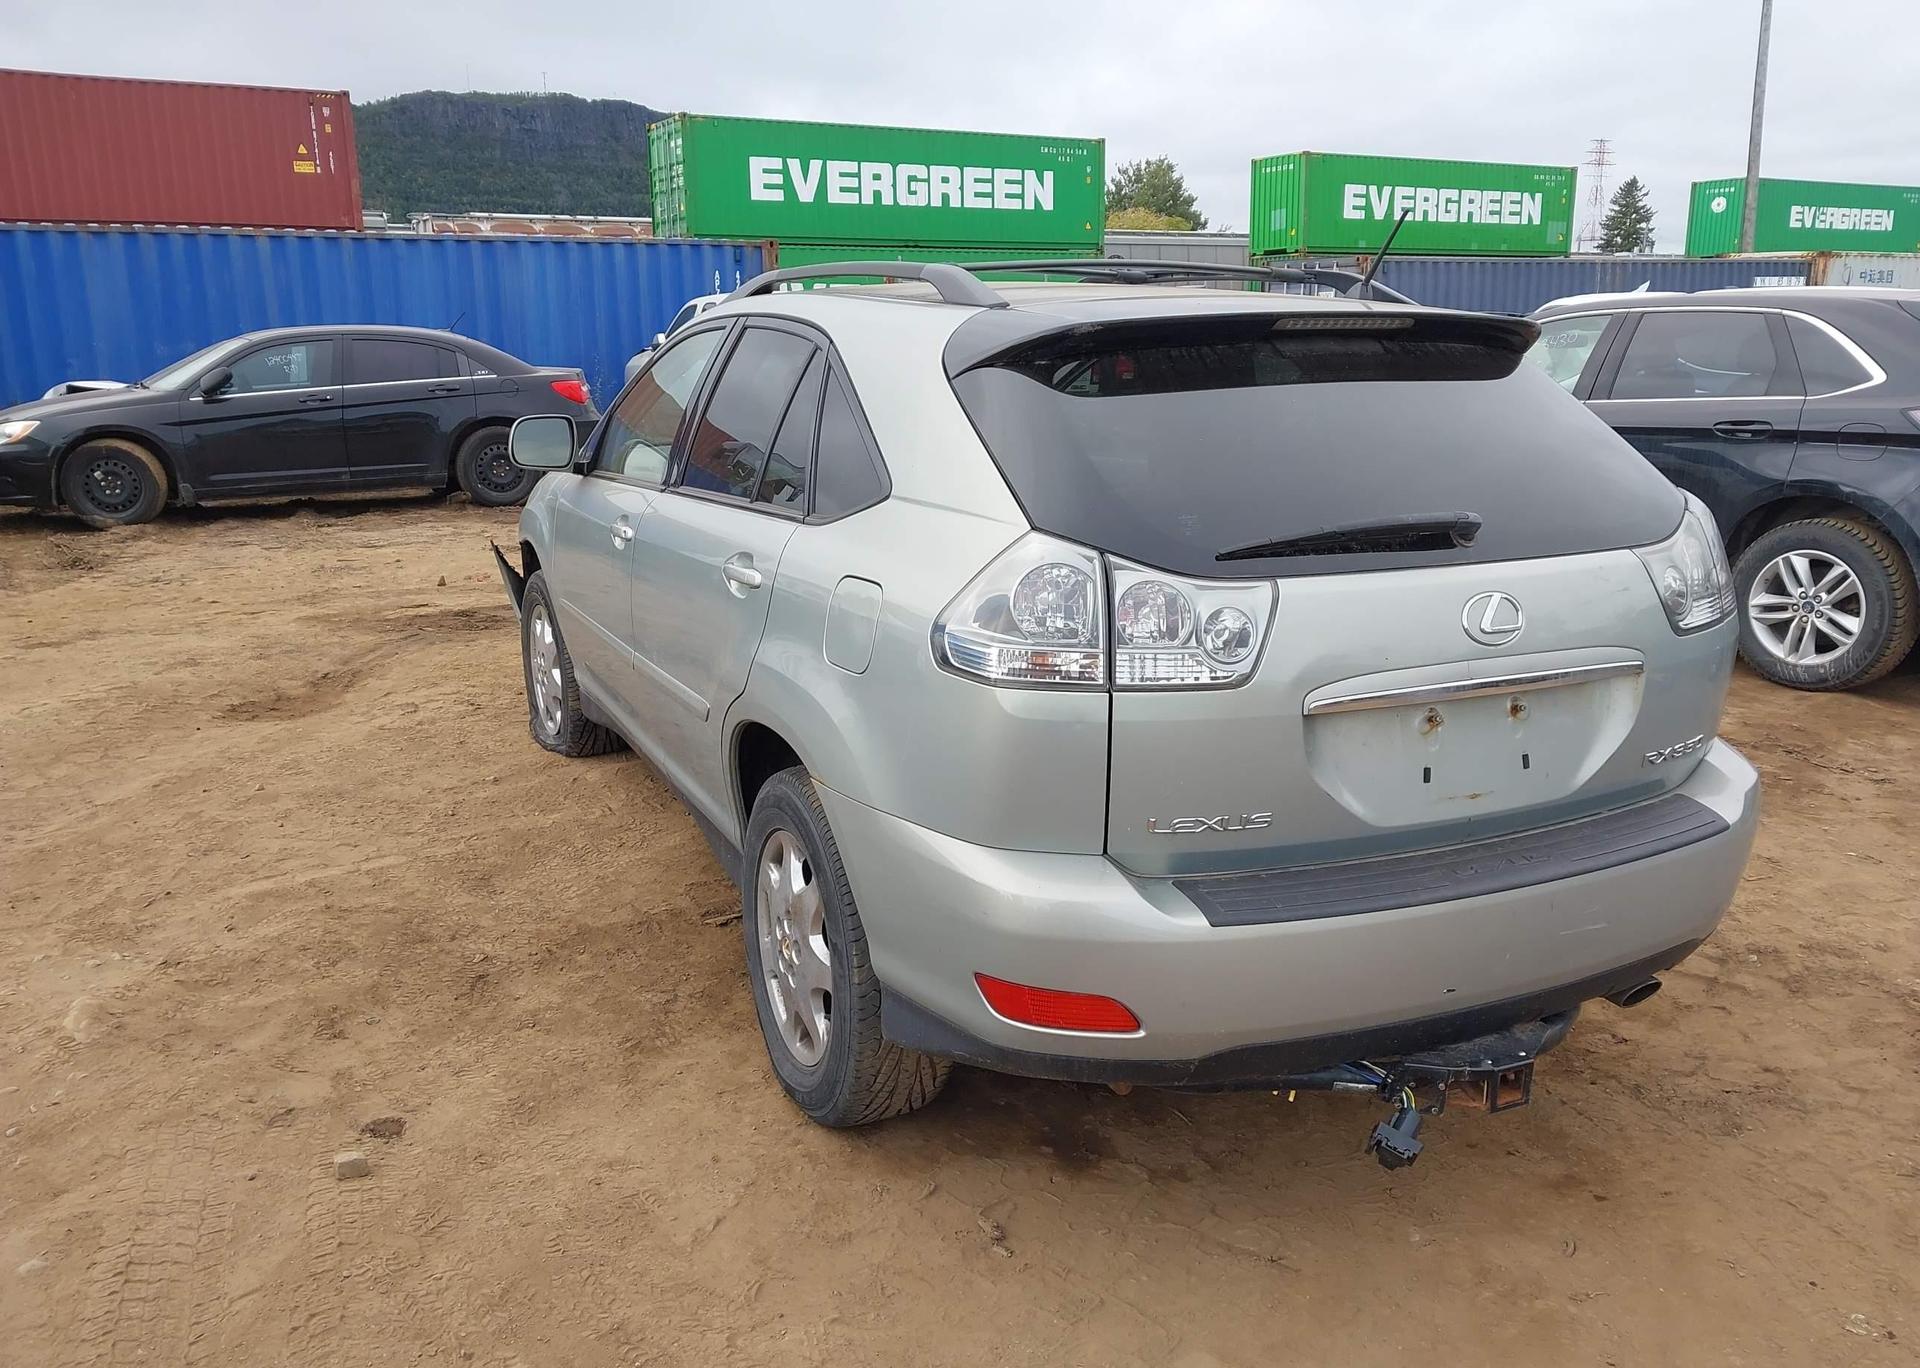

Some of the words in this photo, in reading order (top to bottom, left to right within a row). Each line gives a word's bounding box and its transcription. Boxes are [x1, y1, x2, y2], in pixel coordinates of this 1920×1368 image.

[748, 156, 1055, 211] EVERGREEN
[1343, 183, 1543, 225] EVERGREEN
[1789, 205, 1895, 231] EVERGREEN
[1146, 812, 1273, 834] LEXUS
